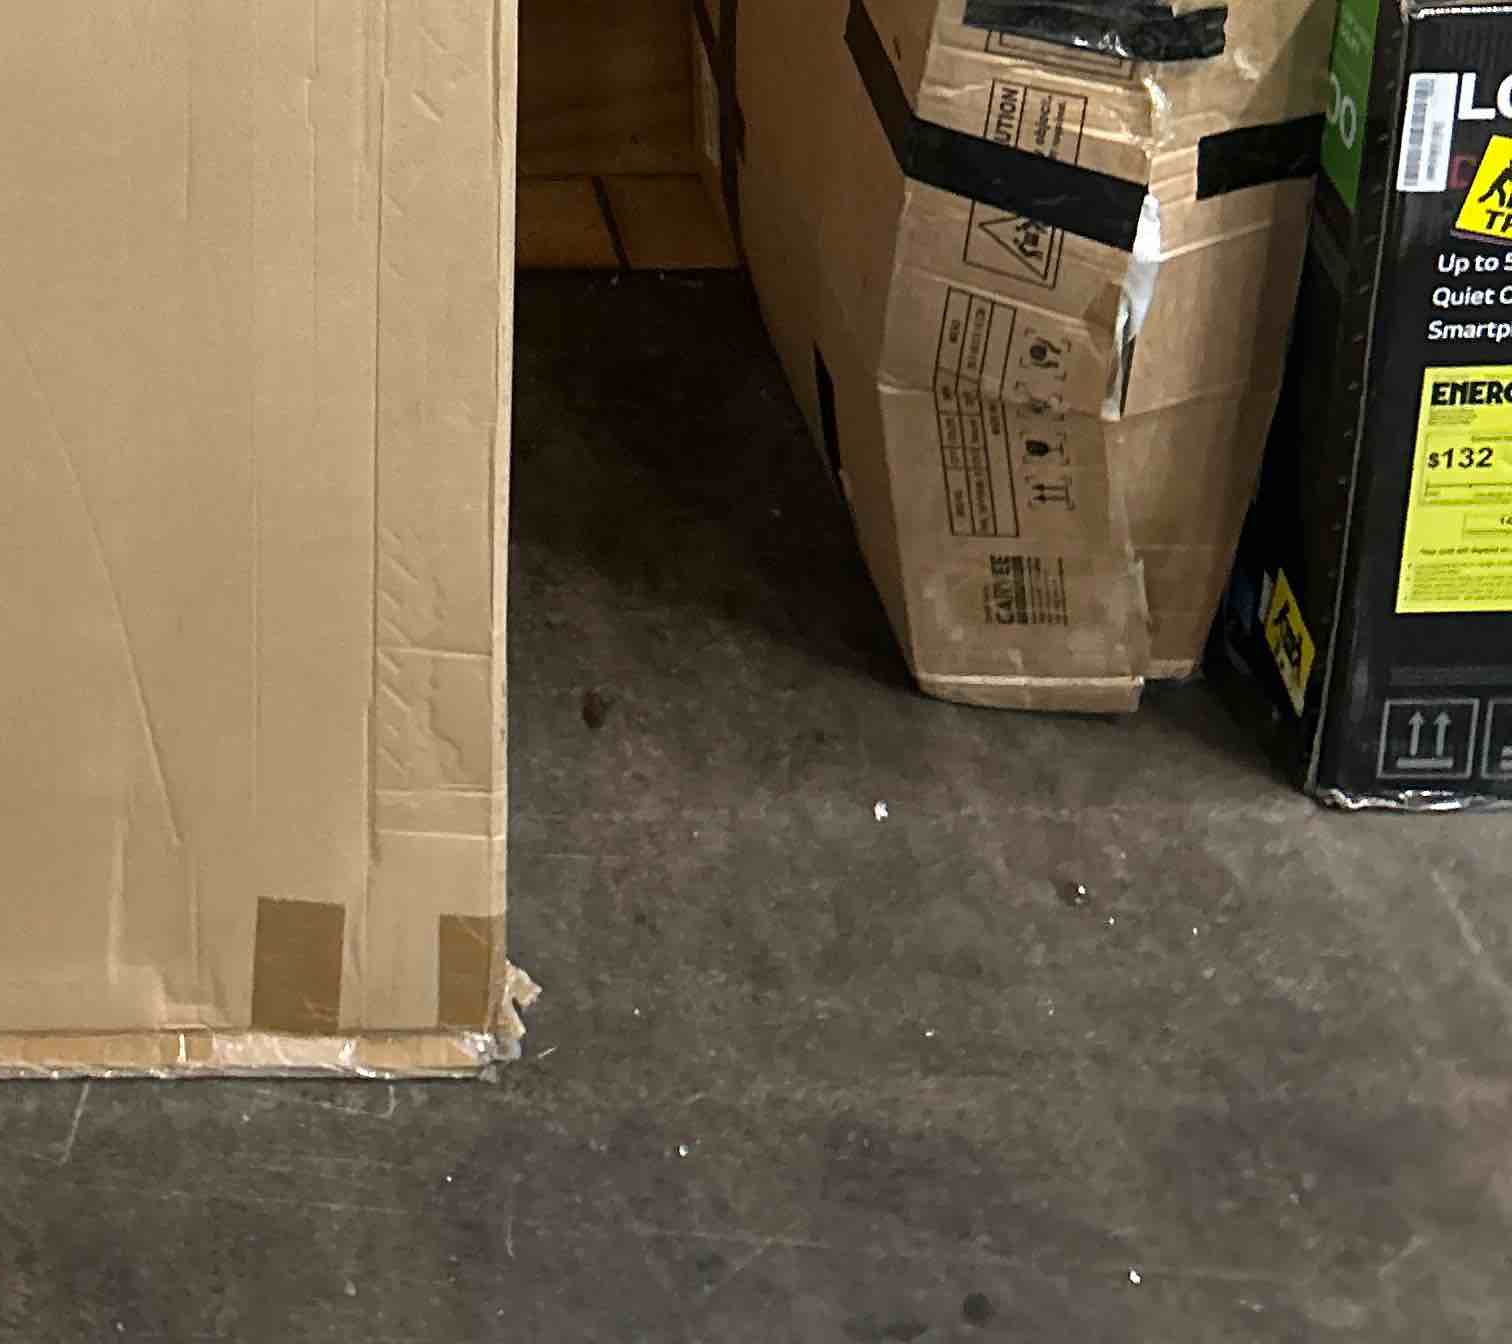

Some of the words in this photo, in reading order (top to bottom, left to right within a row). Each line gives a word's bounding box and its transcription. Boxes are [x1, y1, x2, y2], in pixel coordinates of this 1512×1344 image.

[995, 87, 1020, 145] UTION
[1438, 252, 1469, 276] Up
[1474, 251, 1500, 272] to
[1432, 286, 1496, 309] Quiet
[1428, 318, 1512, 343] Smartp
